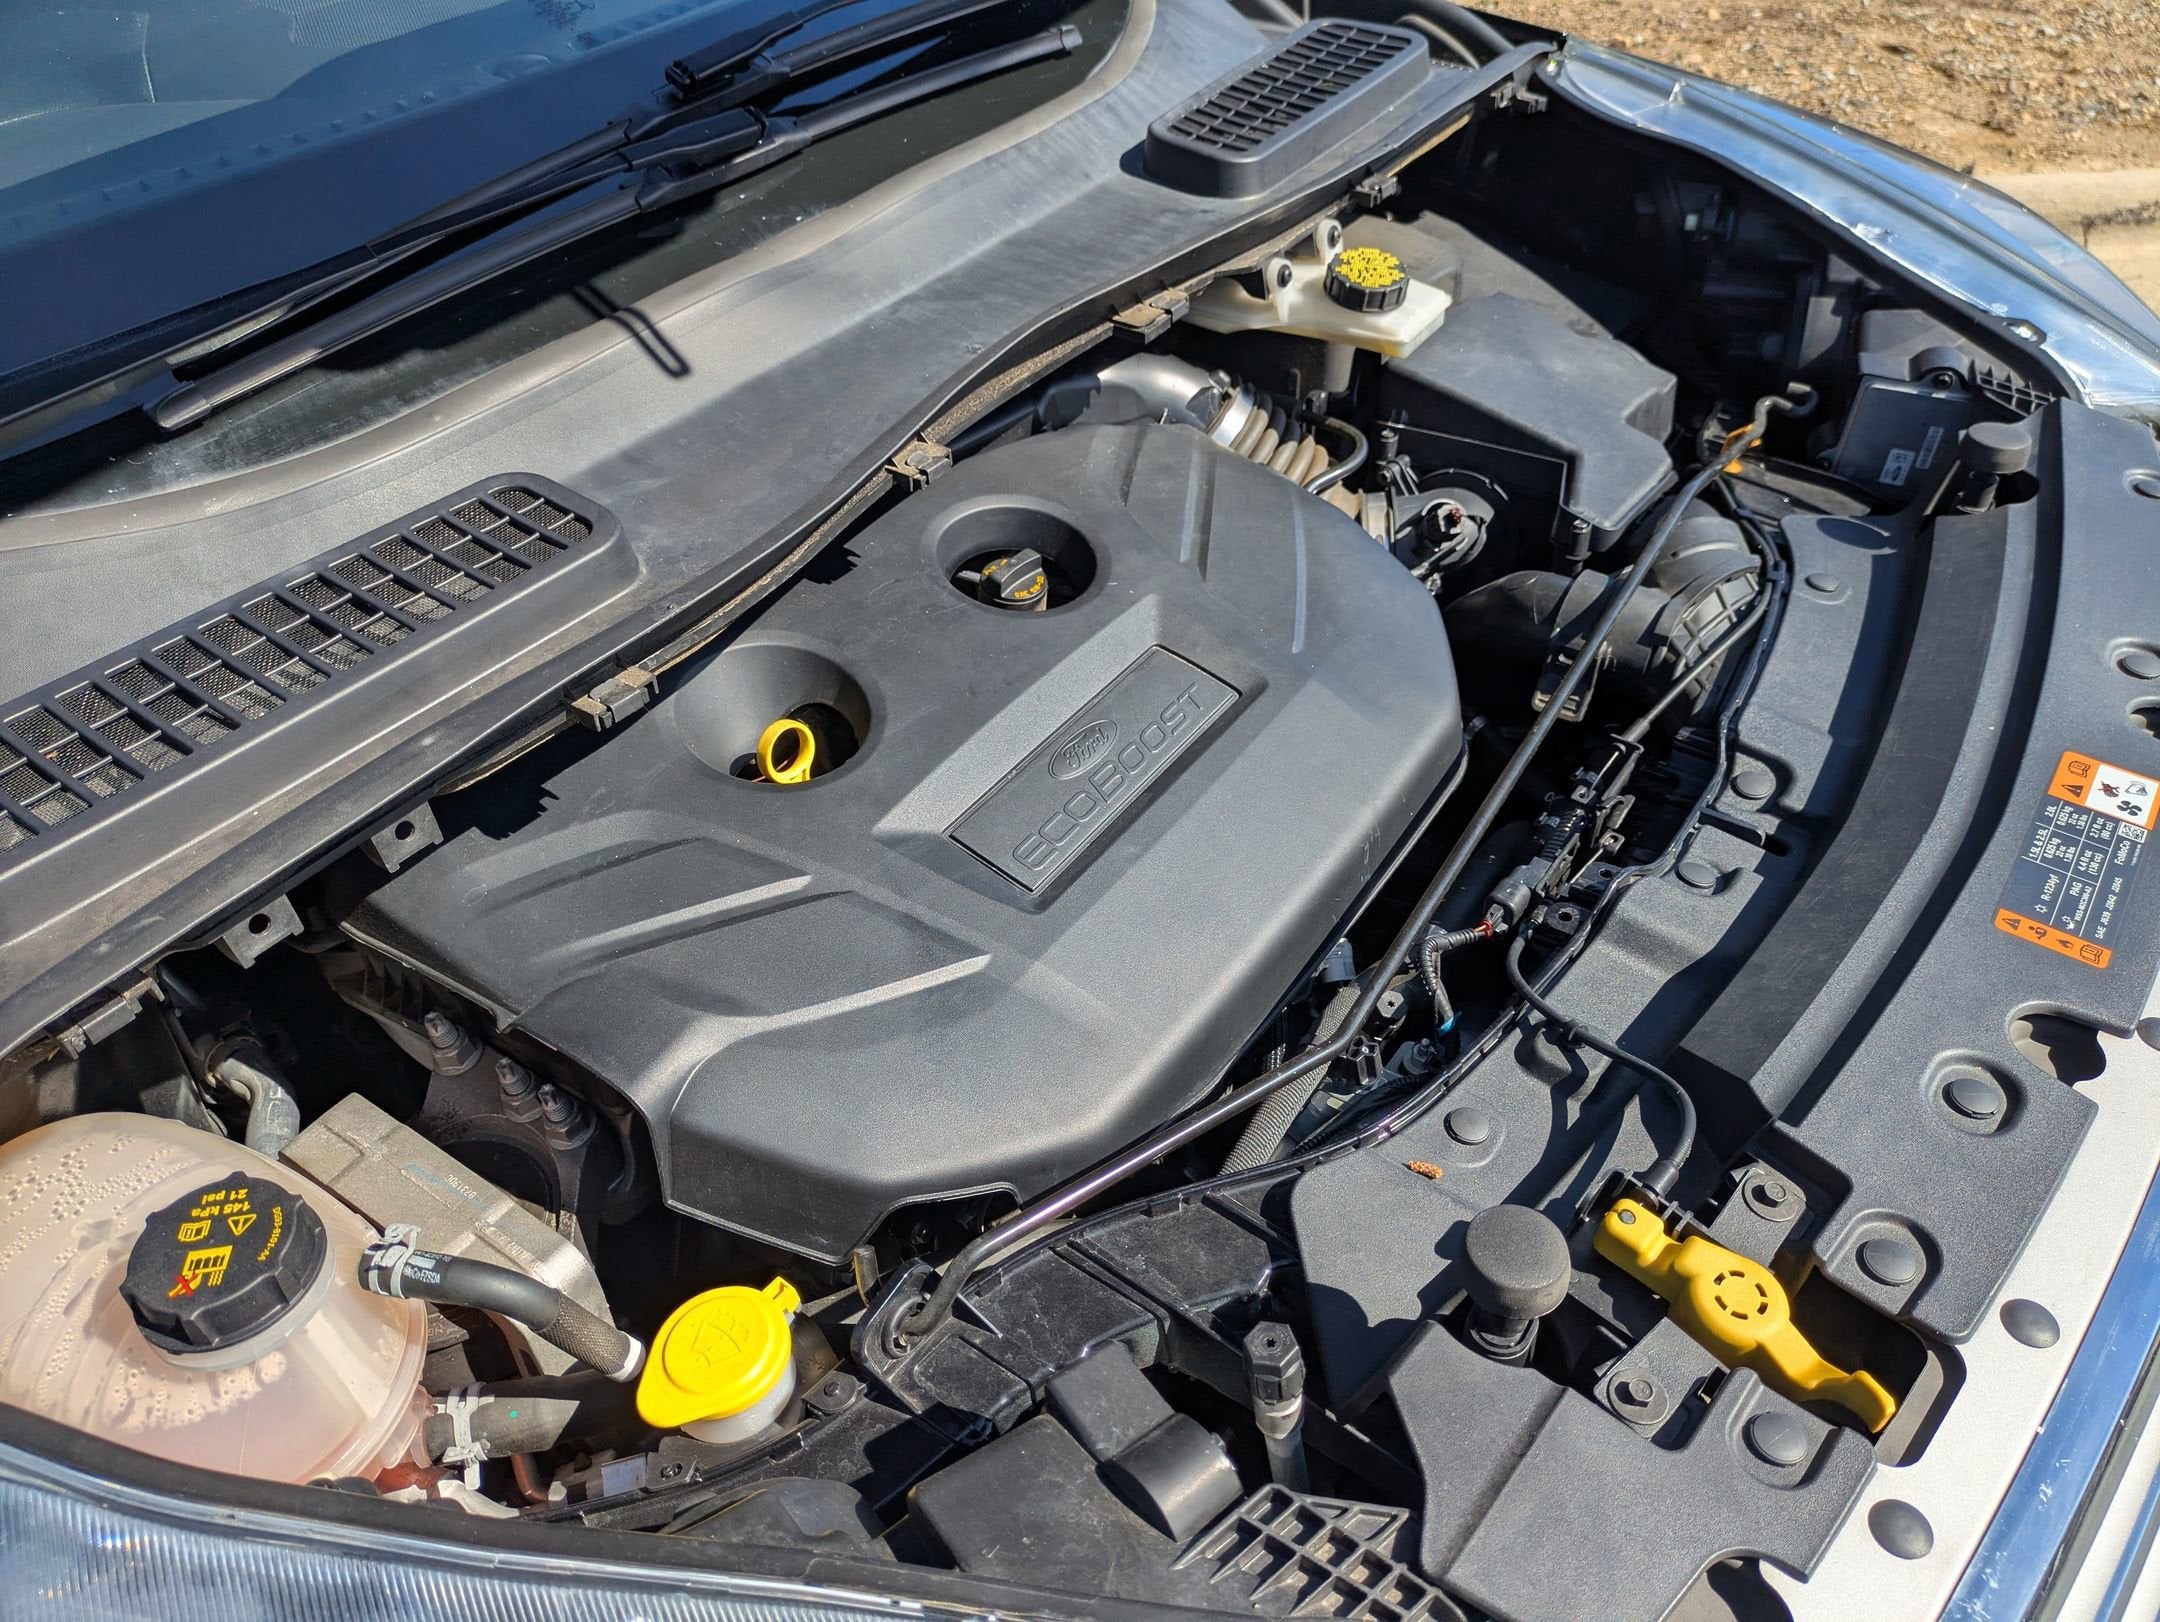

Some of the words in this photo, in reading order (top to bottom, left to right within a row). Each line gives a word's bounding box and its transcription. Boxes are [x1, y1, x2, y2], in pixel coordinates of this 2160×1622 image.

[2044, 805, 2057, 818] 2.0L
[2062, 805, 2074, 814] kg
[2089, 828, 2100, 839] 2.7
[2096, 817, 2105, 825] oz
[2028, 846, 2041, 858] 1.5L
[2036, 828, 2048, 840] 2.5L
[2048, 837, 2062, 846] kg
[2093, 852, 2104, 863] cc)
[2113, 840, 2131, 866] FoMoCo
[2077, 861, 2088, 872] 4.4
[2084, 849, 2093, 858] oz
[2040, 873, 2060, 901] R-1234yf
[2069, 881, 2082, 897] PAG
[2111, 876, 2124, 893] J2845
[2100, 911, 2111, 926] J639
[2095, 925, 2106, 939] SAE
[201, 1190, 226, 1204] psi
[229, 1188, 249, 1200] 21
[191, 1206, 220, 1217] kPa
[223, 1201, 251, 1215] 145
